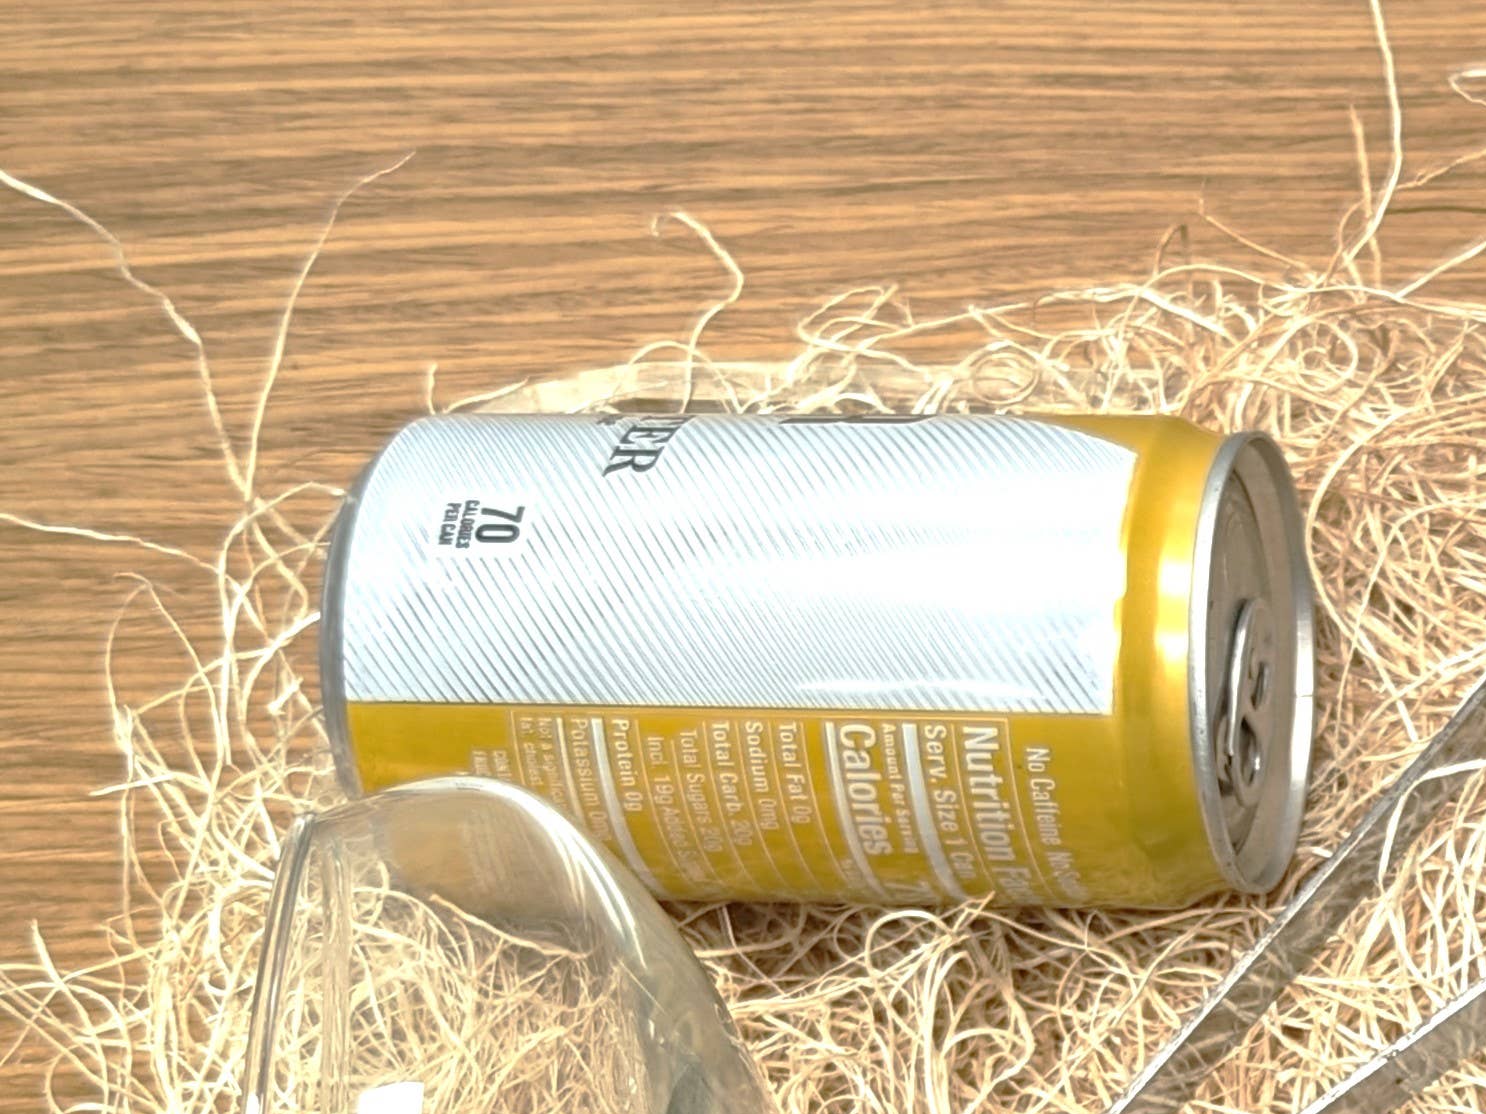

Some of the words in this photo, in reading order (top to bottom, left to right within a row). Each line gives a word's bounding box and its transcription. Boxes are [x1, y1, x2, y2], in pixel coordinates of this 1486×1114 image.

[443, 503, 462, 522] PER
[455, 500, 481, 549] CALORIES
[475, 506, 526, 544] 70
[438, 524, 456, 546] CAN
[570, 719, 601, 808] Potassium
[611, 719, 638, 787] Protein
[679, 729, 701, 769] Total
[711, 721, 735, 766] Total
[779, 721, 805, 767] Total
[882, 723, 902, 779] Amount
[925, 725, 950, 784] Serv.
[1026, 748, 1051, 772] No
[653, 776, 678, 805] 19g
[716, 773, 745, 816] Carb.
[745, 721, 771, 793] Sodium
[758, 798, 780, 831] 0mg
[785, 773, 808, 801] Fat
[839, 724, 893, 855] Calories
[890, 783, 907, 806] Per
[963, 726, 1016, 860] Nutrition
[624, 791, 644, 812] 0g
[686, 773, 714, 824] Sugars
[790, 805, 813, 825] 0g
[934, 789, 960, 832] Size
[1030, 779, 1061, 845] Caffeine
